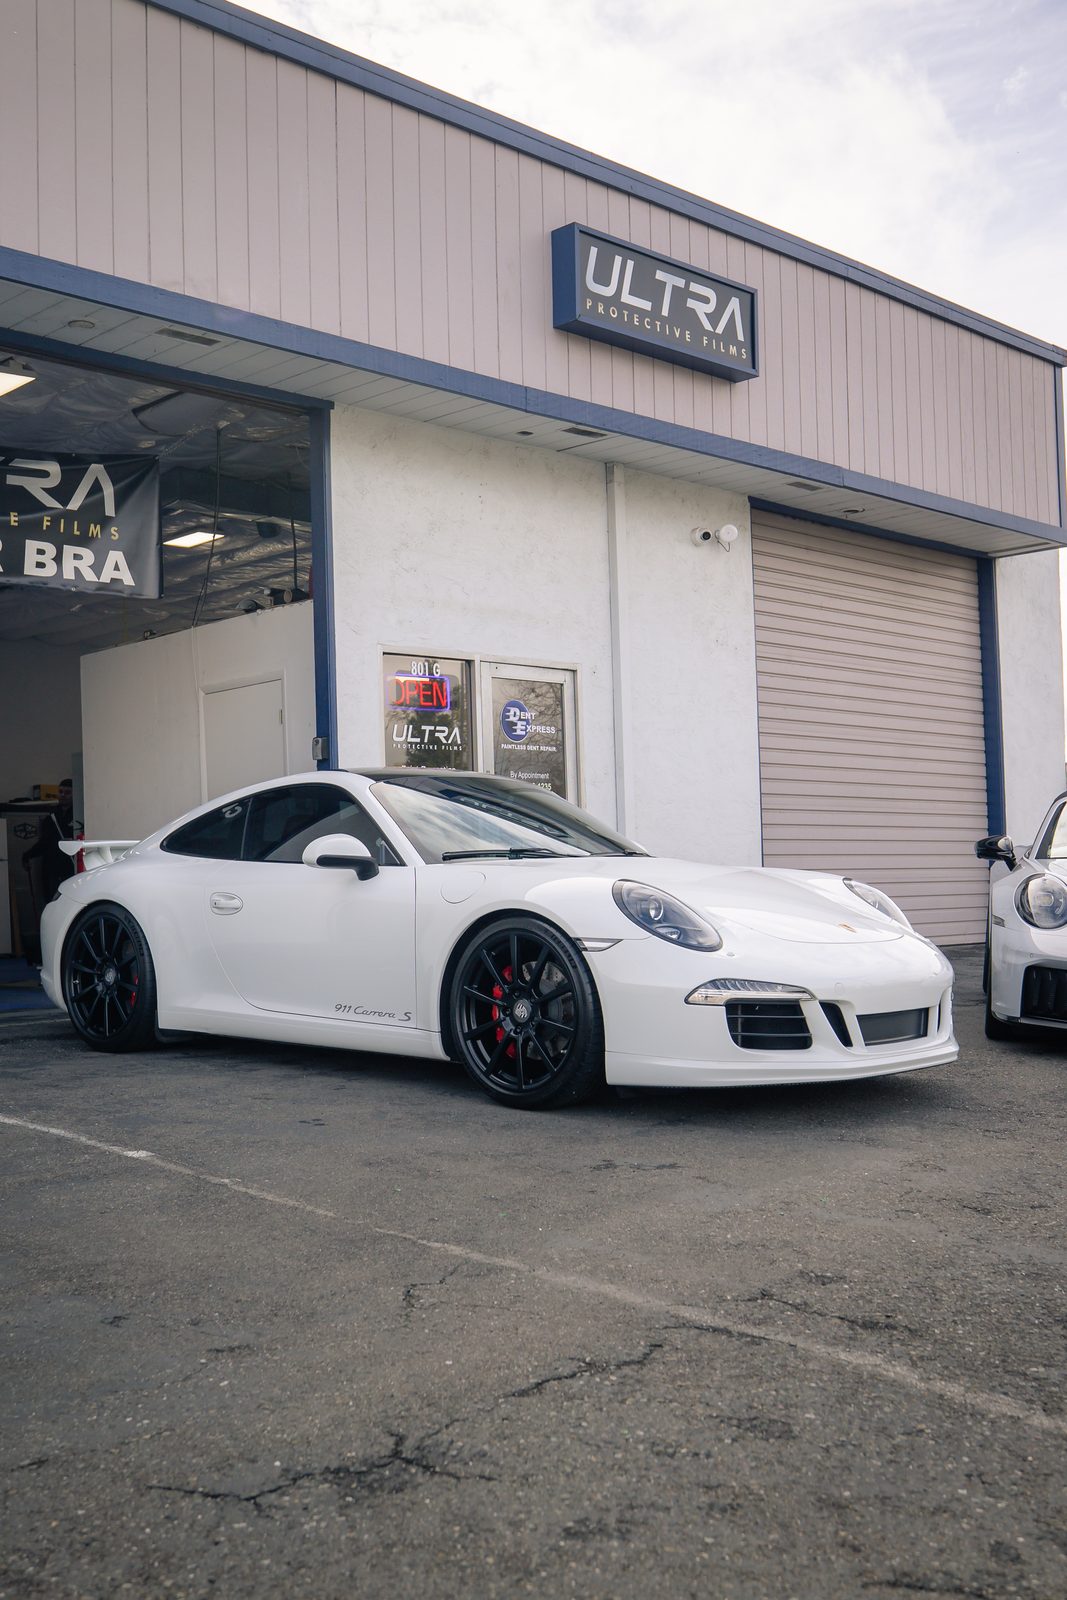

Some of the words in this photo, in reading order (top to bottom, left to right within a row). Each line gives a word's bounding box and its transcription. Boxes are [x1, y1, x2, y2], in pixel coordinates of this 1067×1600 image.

[585, 245, 745, 342] ULTRA
[586, 298, 692, 342] PROTECTIVE
[703, 335, 747, 360] FILMS
[0, 456, 116, 517] RA
[42, 515, 120, 541] FILMS
[23, 538, 136, 587] BRA
[411, 661, 429, 676] 801
[433, 663, 441, 677] G
[390, 678, 447, 707] OPEN
[504, 706, 536, 721] DENT
[392, 724, 462, 744] ULTRA
[512, 720, 556, 736] EXPRESS
[501, 743, 526, 751] PAINTLESS
[510, 770, 517, 779] By
[518, 771, 550, 780] Appointment
[334, 1003, 352, 1014] 911
[353, 1005, 396, 1019] Carrera
[398, 1011, 413, 1022] S
